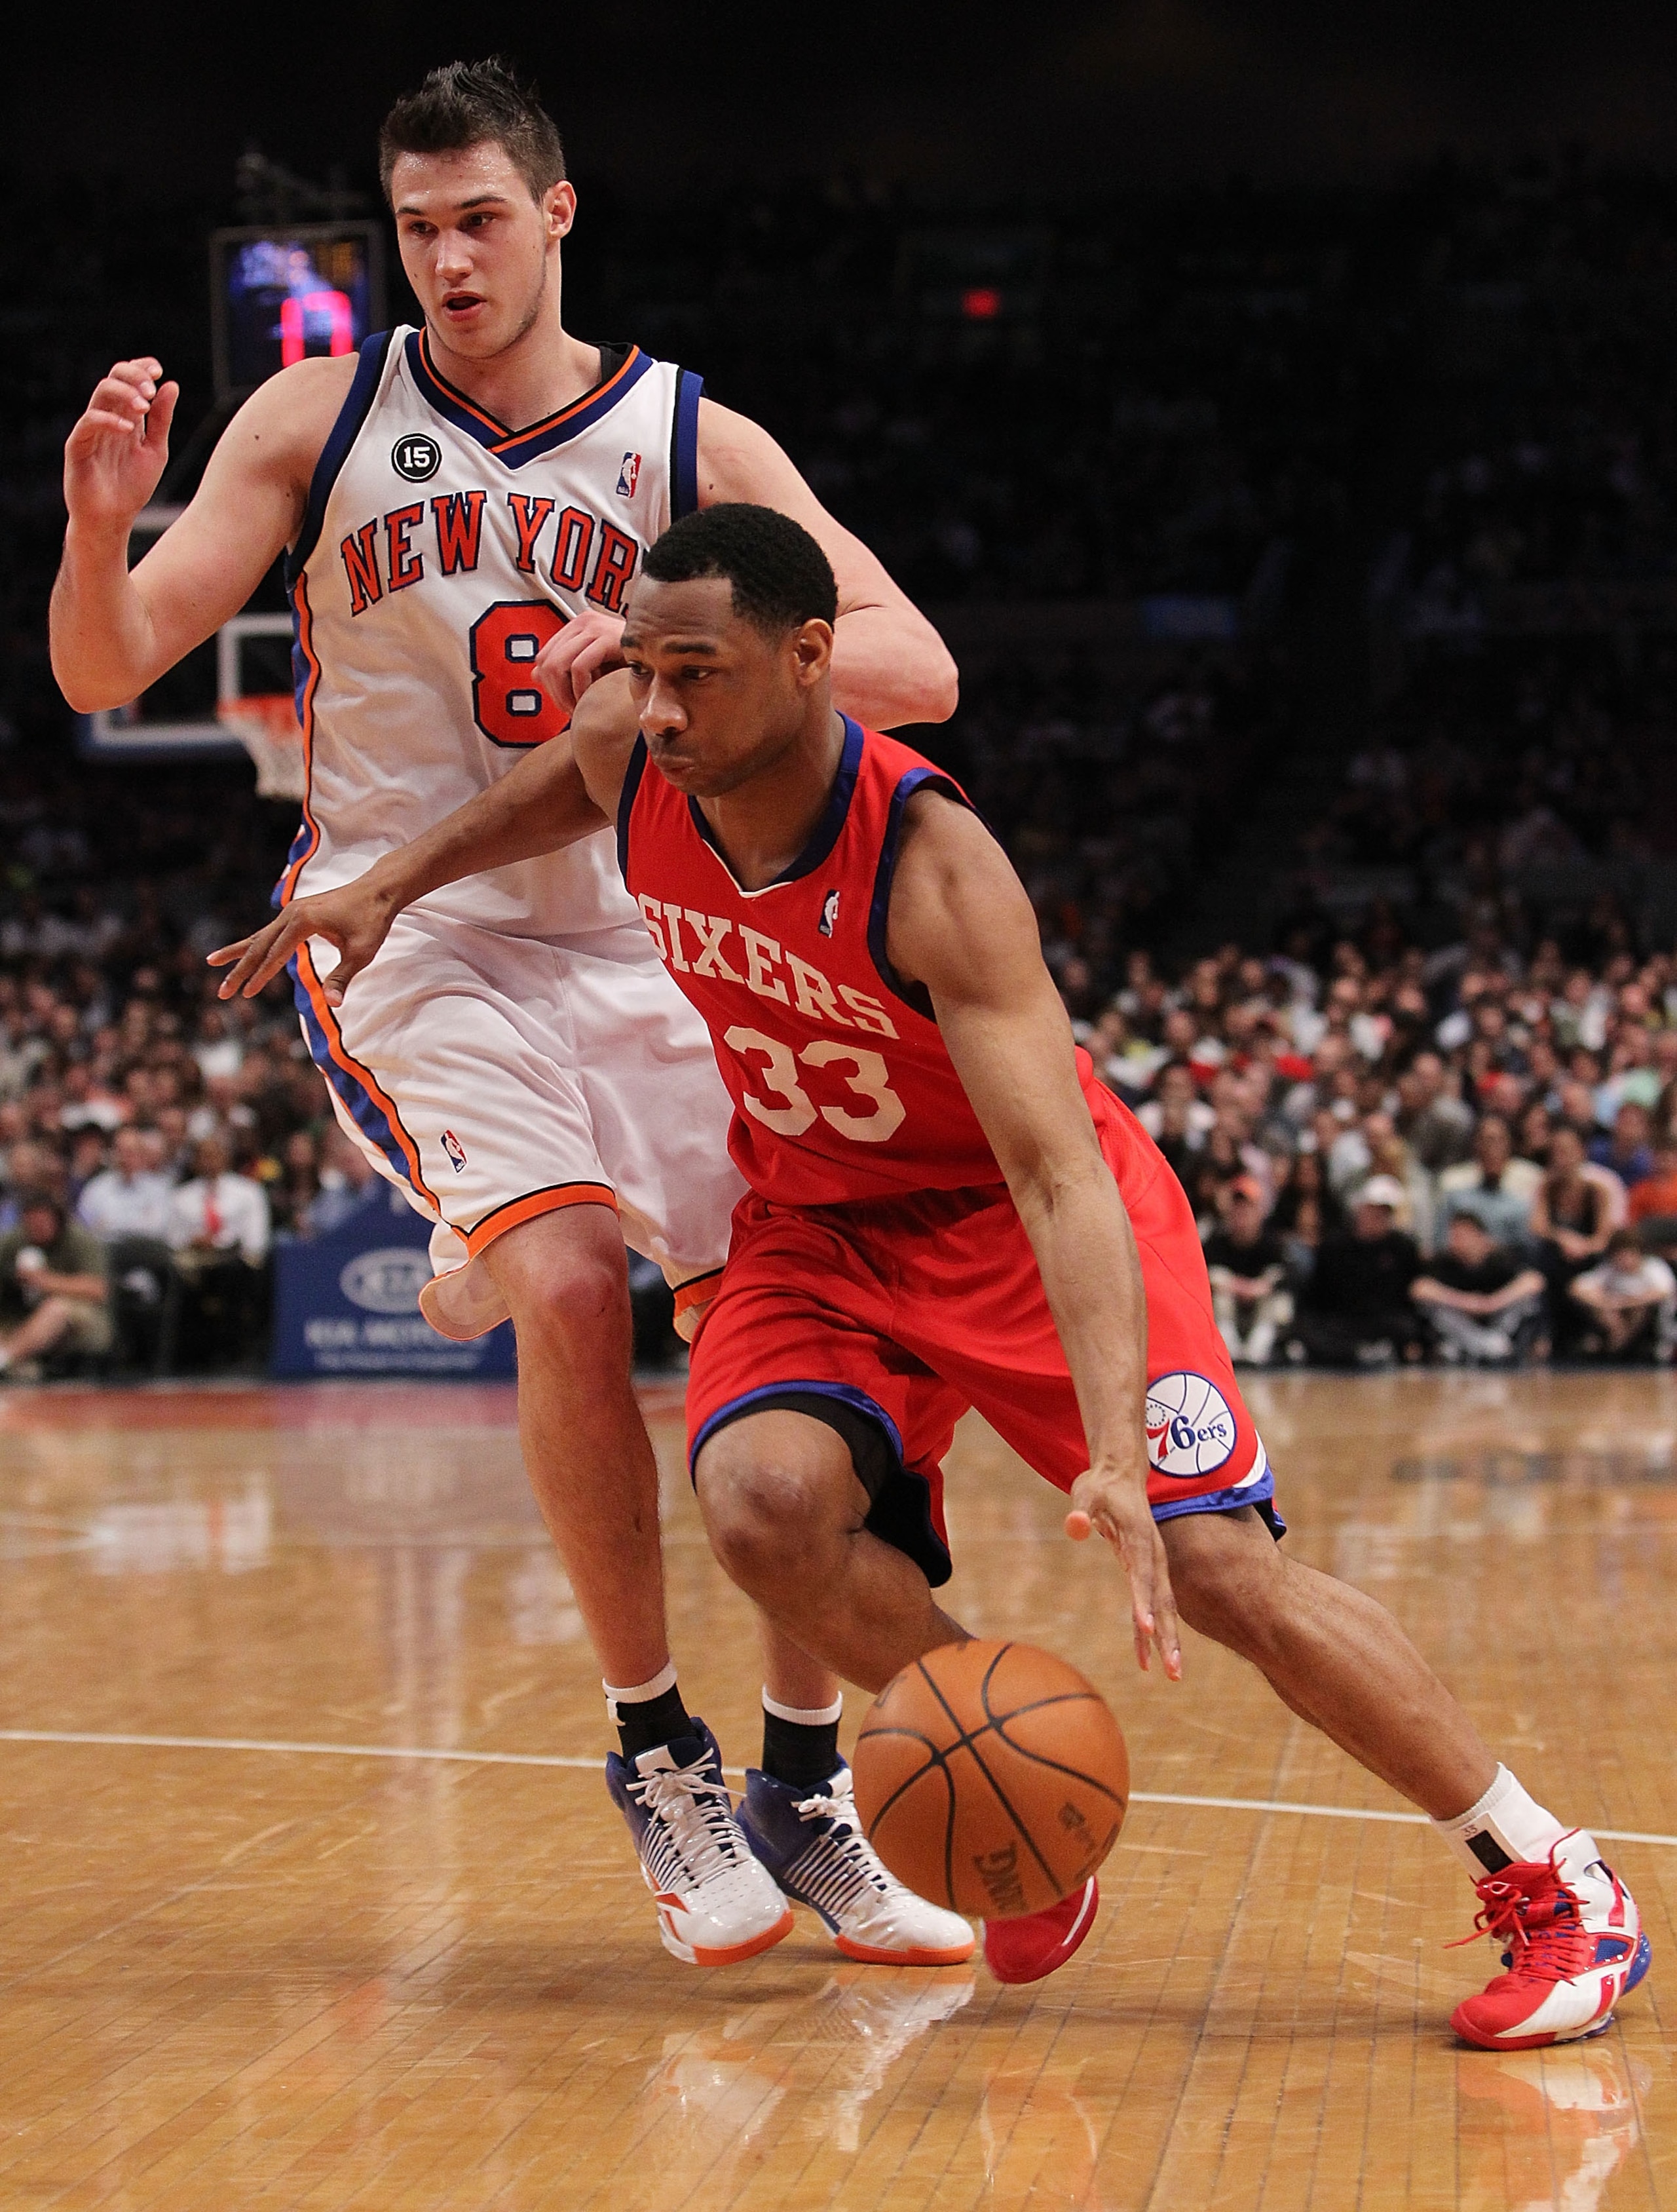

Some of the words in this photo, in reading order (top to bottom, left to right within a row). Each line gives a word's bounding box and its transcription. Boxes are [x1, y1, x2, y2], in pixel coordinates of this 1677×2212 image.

[404, 446, 431, 469] 15
[341, 490, 487, 618] NEW
[507, 493, 640, 619] YOR
[469, 600, 572, 748] 8
[637, 892, 901, 1040] SIXERS
[723, 1025, 907, 1143] 33
[1146, 1416, 1227, 1460] 76ers
